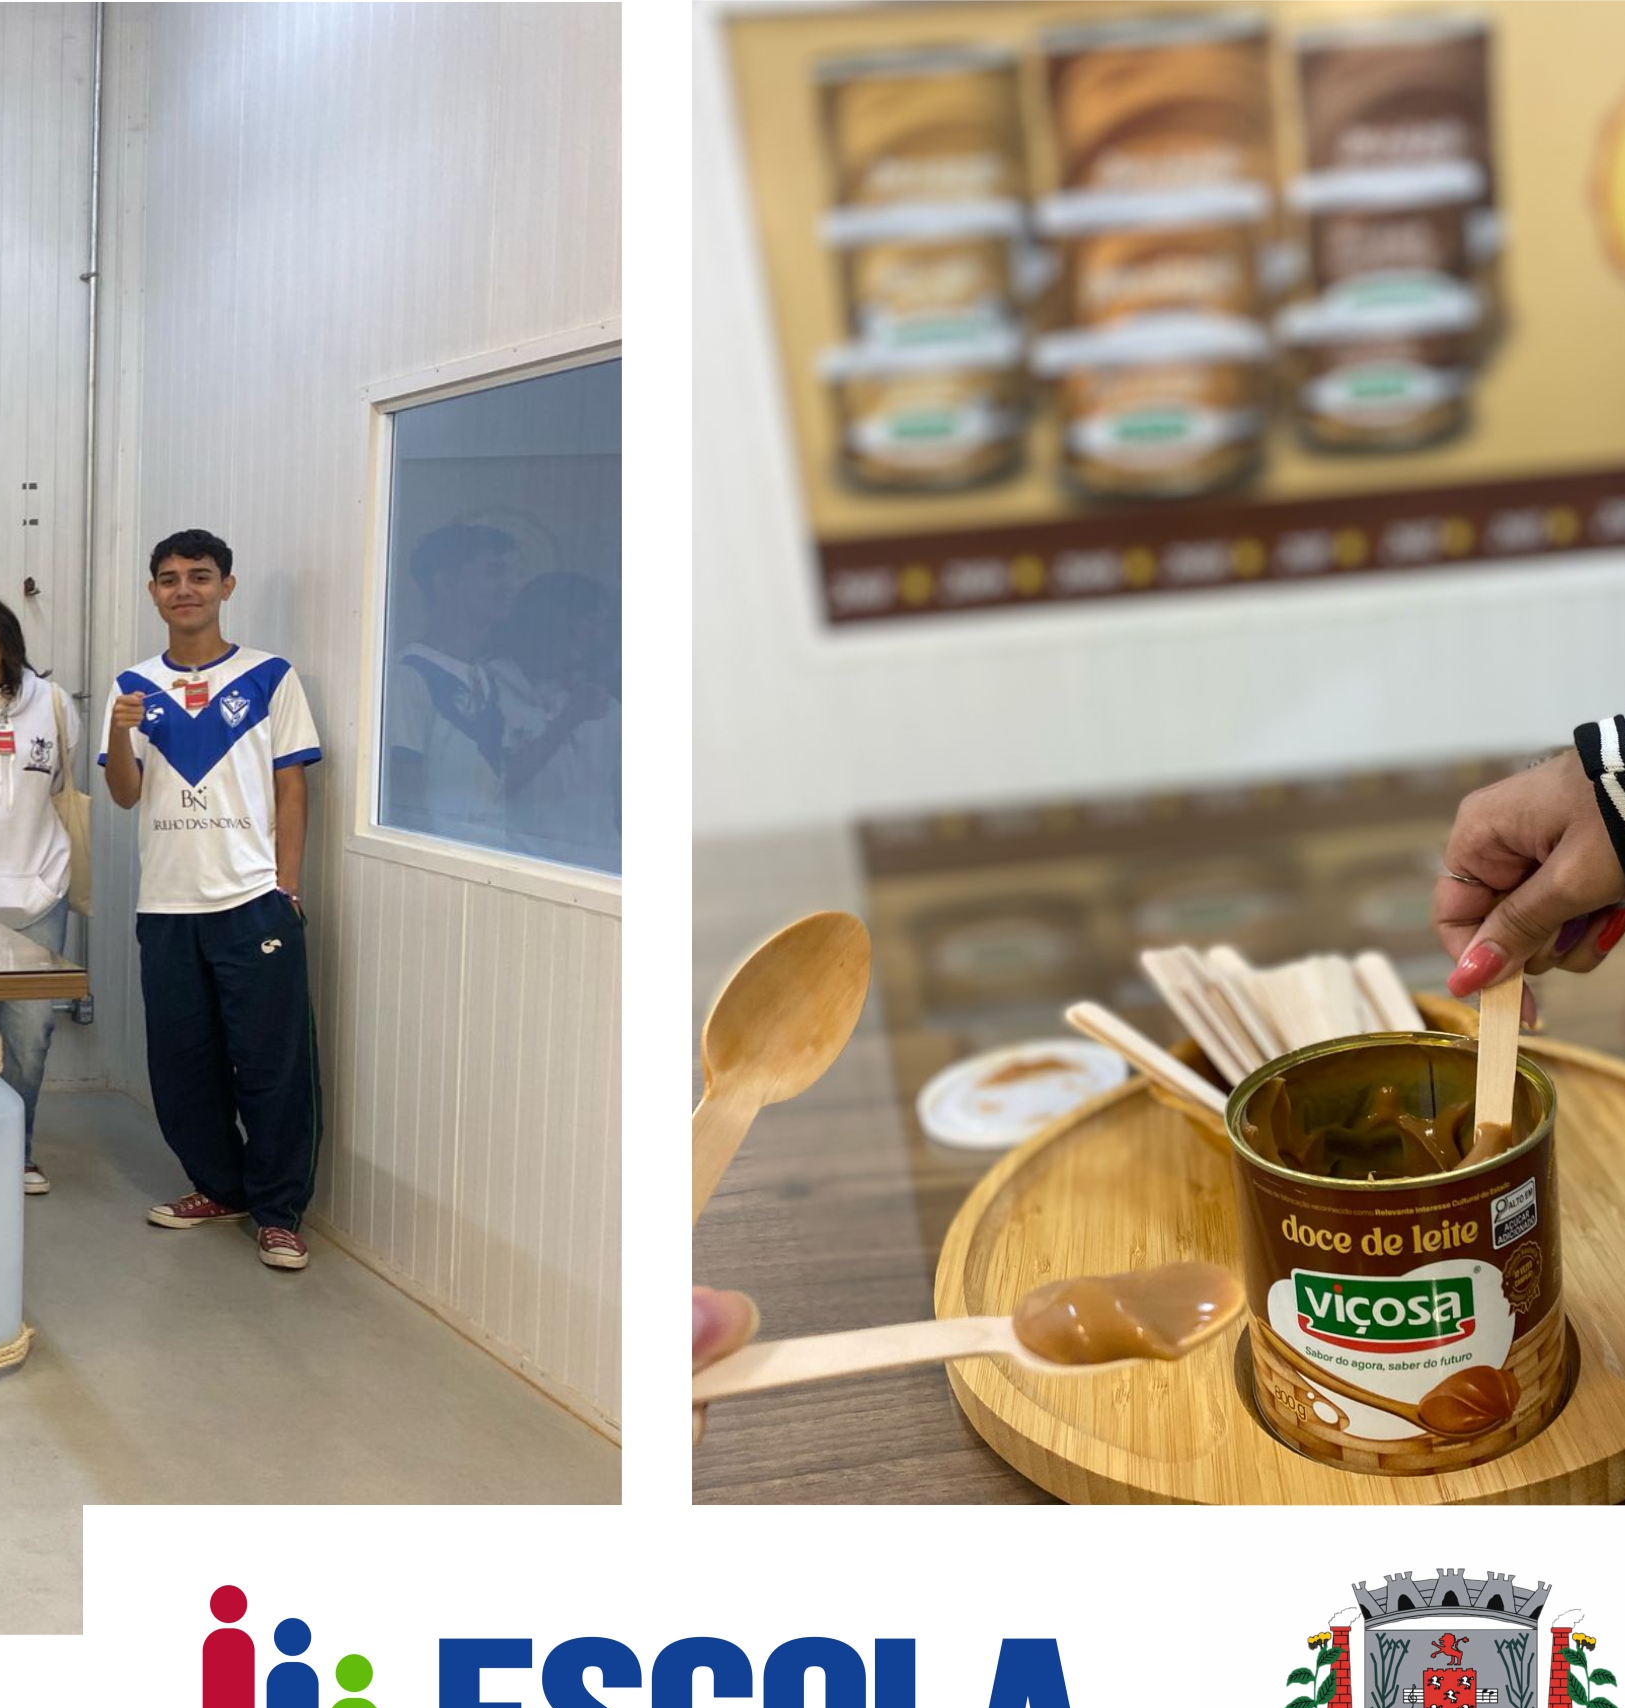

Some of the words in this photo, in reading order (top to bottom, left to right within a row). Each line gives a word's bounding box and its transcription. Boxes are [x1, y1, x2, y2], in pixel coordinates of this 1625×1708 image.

[186, 817, 209, 830] DAS
[209, 816, 252, 830] NOIVAS
[1375, 1208, 1415, 1217] Relevante
[1415, 1202, 1451, 1214] Interesse
[1452, 1193, 1480, 1208] Cultural
[1508, 1194, 1525, 1210] ALTO
[1524, 1187, 1533, 1201] EM
[1281, 1214, 1353, 1254] doce
[1361, 1227, 1404, 1256] de
[1412, 1219, 1479, 1254] leite
[1497, 1215, 1535, 1245] ADICIONADO
[1304, 1284, 1462, 1336] viçosa
[1305, 1346, 1334, 1363] Sabor
[1335, 1352, 1349, 1366] do
[1351, 1360, 1386, 1372] agora,
[1388, 1359, 1421, 1371] saber
[1423, 1356, 1438, 1369] do
[1439, 1350, 1473, 1366] futuro
